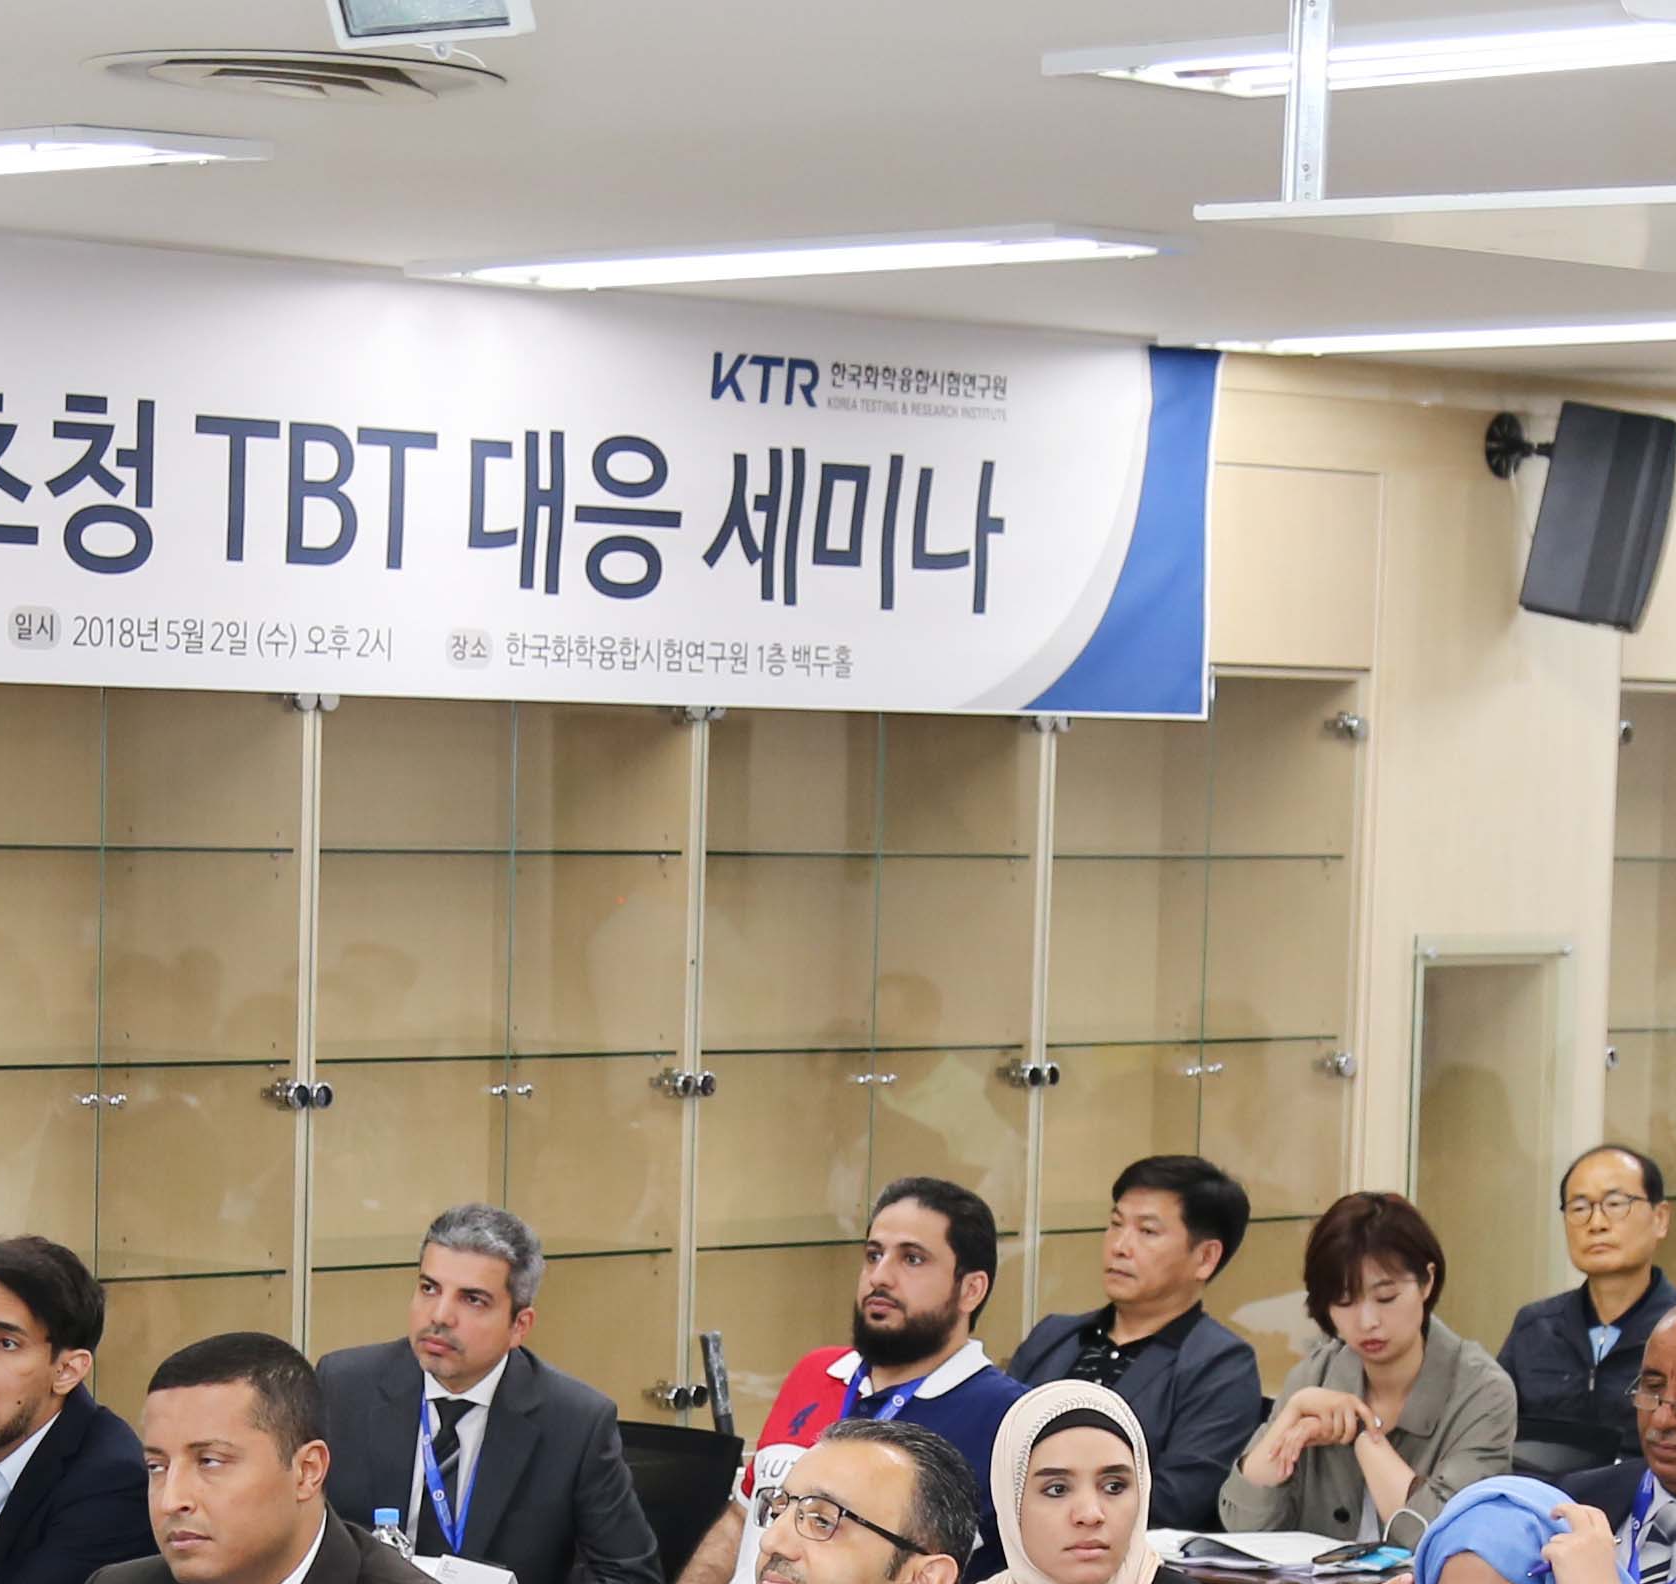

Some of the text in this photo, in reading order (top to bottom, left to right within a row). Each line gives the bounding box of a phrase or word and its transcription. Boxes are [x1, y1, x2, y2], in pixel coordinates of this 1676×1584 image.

[711, 351, 820, 408] KTR
[830, 361, 1009, 402] 한국화학융합시험연구원
[194, 415, 439, 570] TBT
[467, 430, 683, 598] 대응
[701, 447, 1006, 614] 세미나
[14, 612, 394, 662] 일시 2018년 5월 2일 (수) 오후 2시
[451, 632, 854, 680] 장소 한국화학융합시험연구원 1층 백두홀
